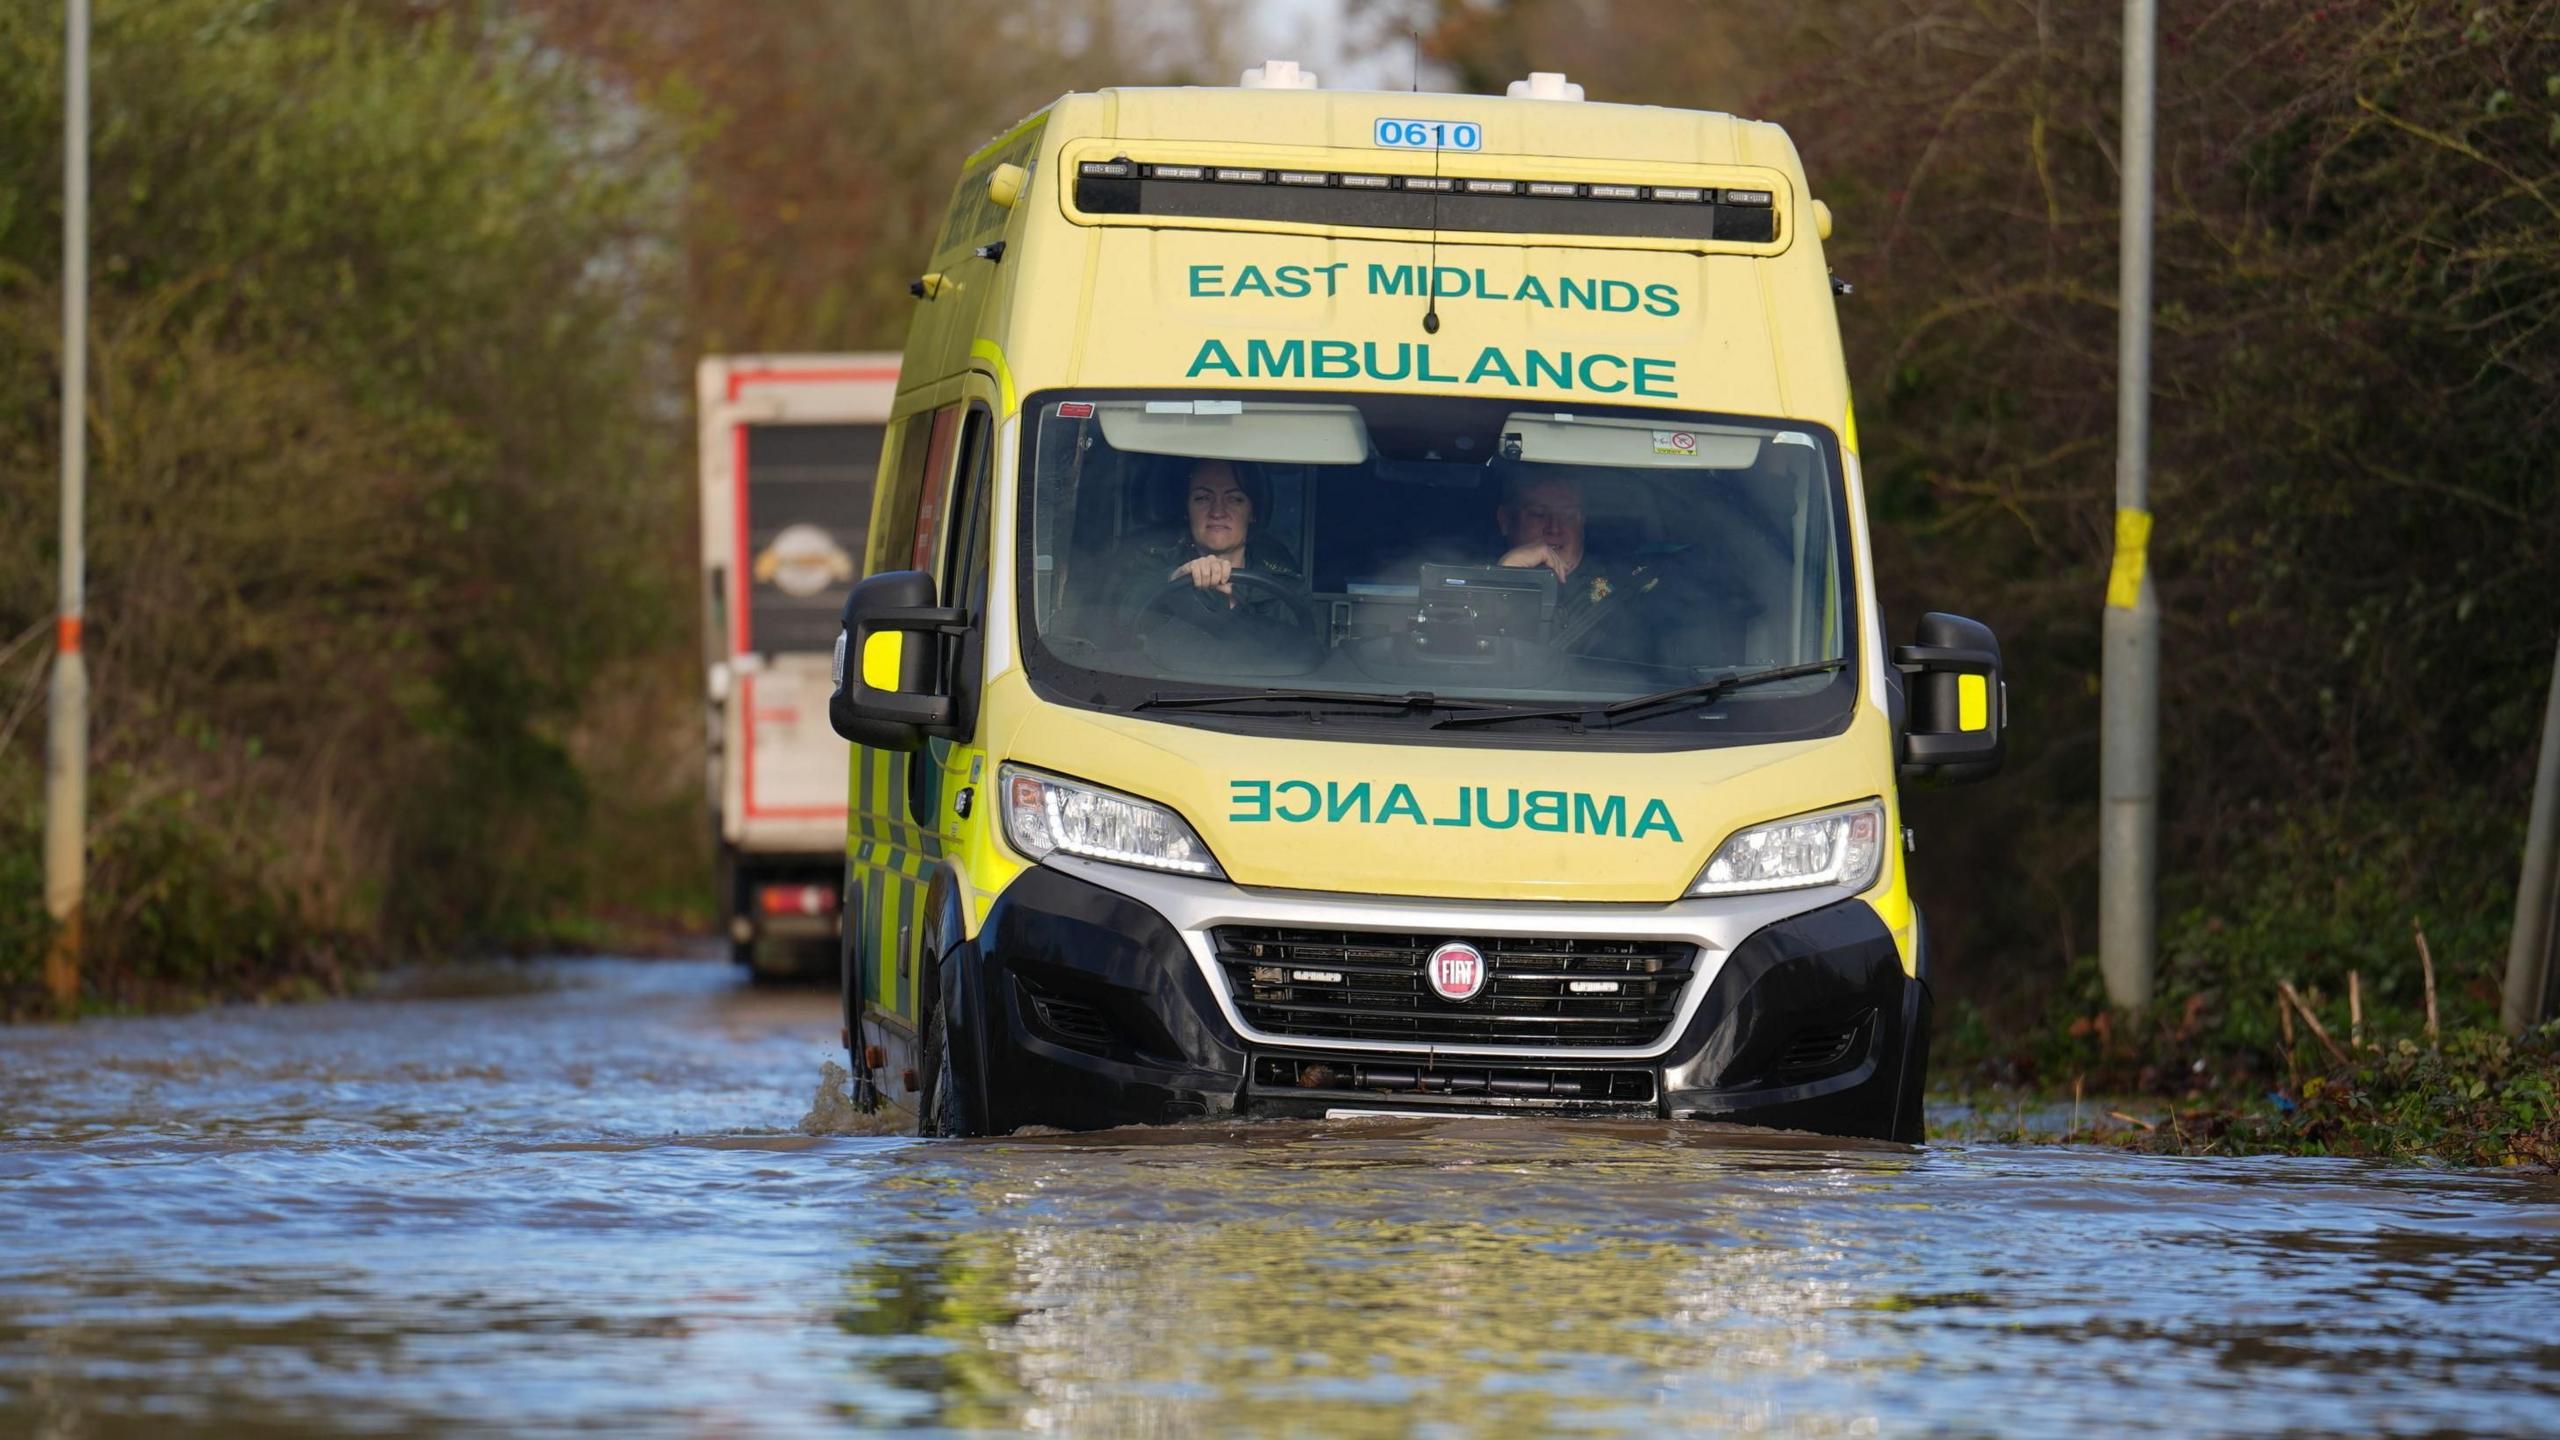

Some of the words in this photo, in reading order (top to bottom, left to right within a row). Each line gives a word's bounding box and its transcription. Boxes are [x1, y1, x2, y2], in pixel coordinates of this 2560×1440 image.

[1380, 121, 1476, 148] 0610
[1189, 264, 1348, 298] EAST
[1368, 264, 1680, 317] MIDLANDS
[1187, 339, 1678, 399] AMBULANCE
[1442, 960, 1474, 985] FIAT
